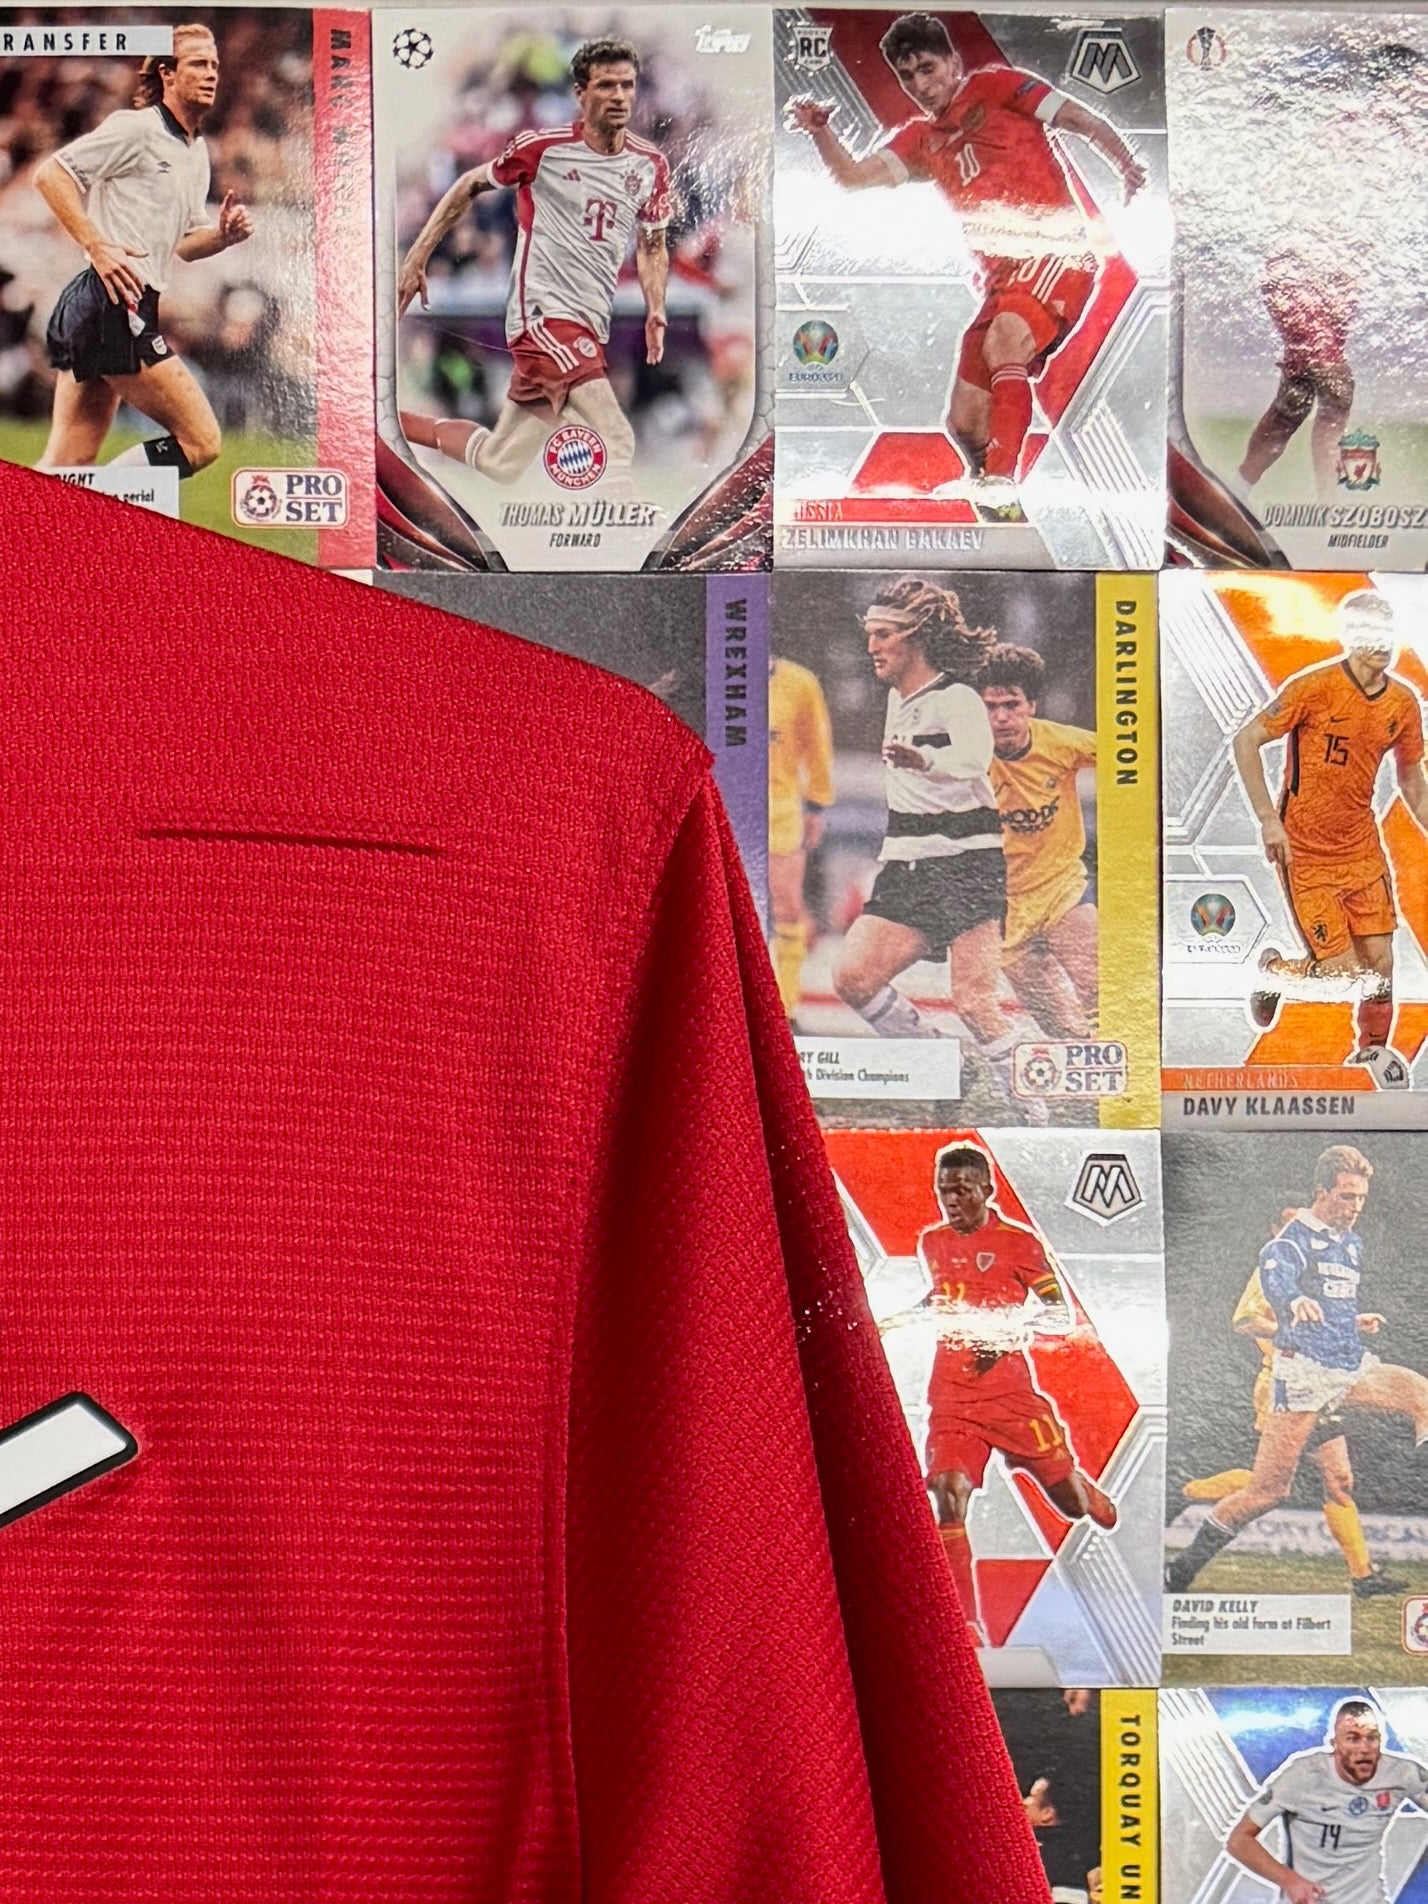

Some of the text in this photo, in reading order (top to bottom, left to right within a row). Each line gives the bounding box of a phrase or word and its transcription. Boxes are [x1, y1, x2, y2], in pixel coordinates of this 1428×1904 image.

[286, 475, 342, 496] PRO
[286, 502, 342, 522] SET
[499, 500, 657, 527] THOMAS MÜLLER
[549, 533, 601, 548] FORWARD
[724, 600, 748, 748] WREXHAM
[1114, 600, 1138, 786] DARLINGTON
[1066, 1045, 1122, 1065] PRO
[1066, 1072, 1122, 1092] SET
[1182, 1096, 1355, 1116] DAVY KLAASSEN
[1172, 1599, 1259, 1614] DAVID KELLY
[1118, 1714, 1142, 1847] TORQUAY
